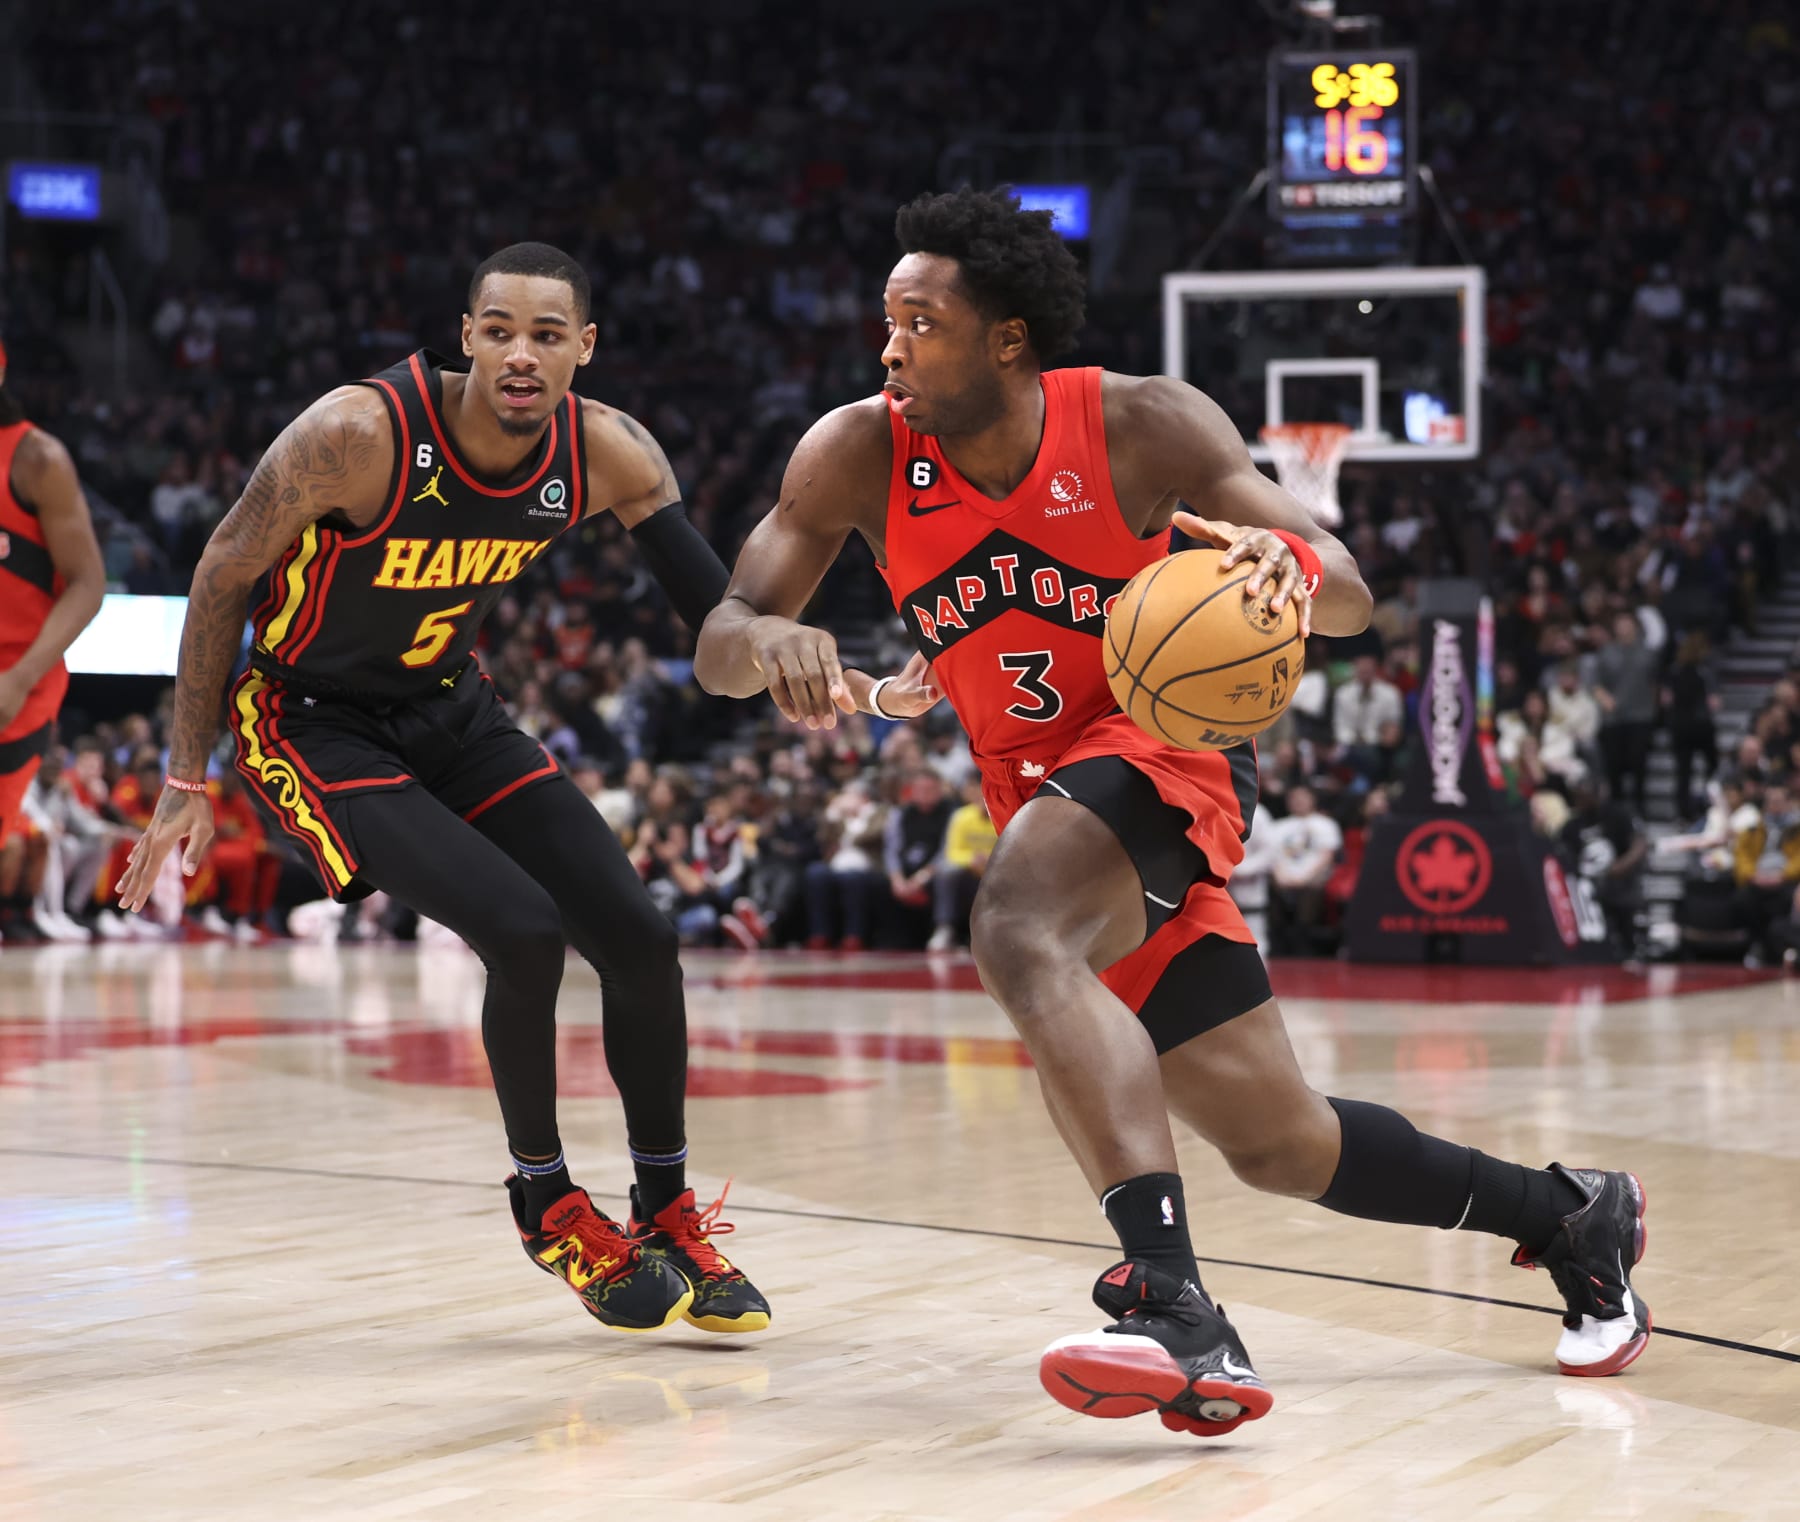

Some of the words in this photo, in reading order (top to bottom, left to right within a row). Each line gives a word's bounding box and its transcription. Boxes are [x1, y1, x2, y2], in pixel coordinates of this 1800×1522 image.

[1311, 62, 1399, 108] 5:36
[1325, 105, 1388, 174] 16
[416, 443, 432, 468] 6
[912, 462, 931, 486] 6
[528, 508, 568, 519] sharecare
[1044, 506, 1070, 518] Sun
[1071, 499, 1096, 513] Life
[399, 600, 475, 669] 5
[998, 650, 1063, 722] 3
